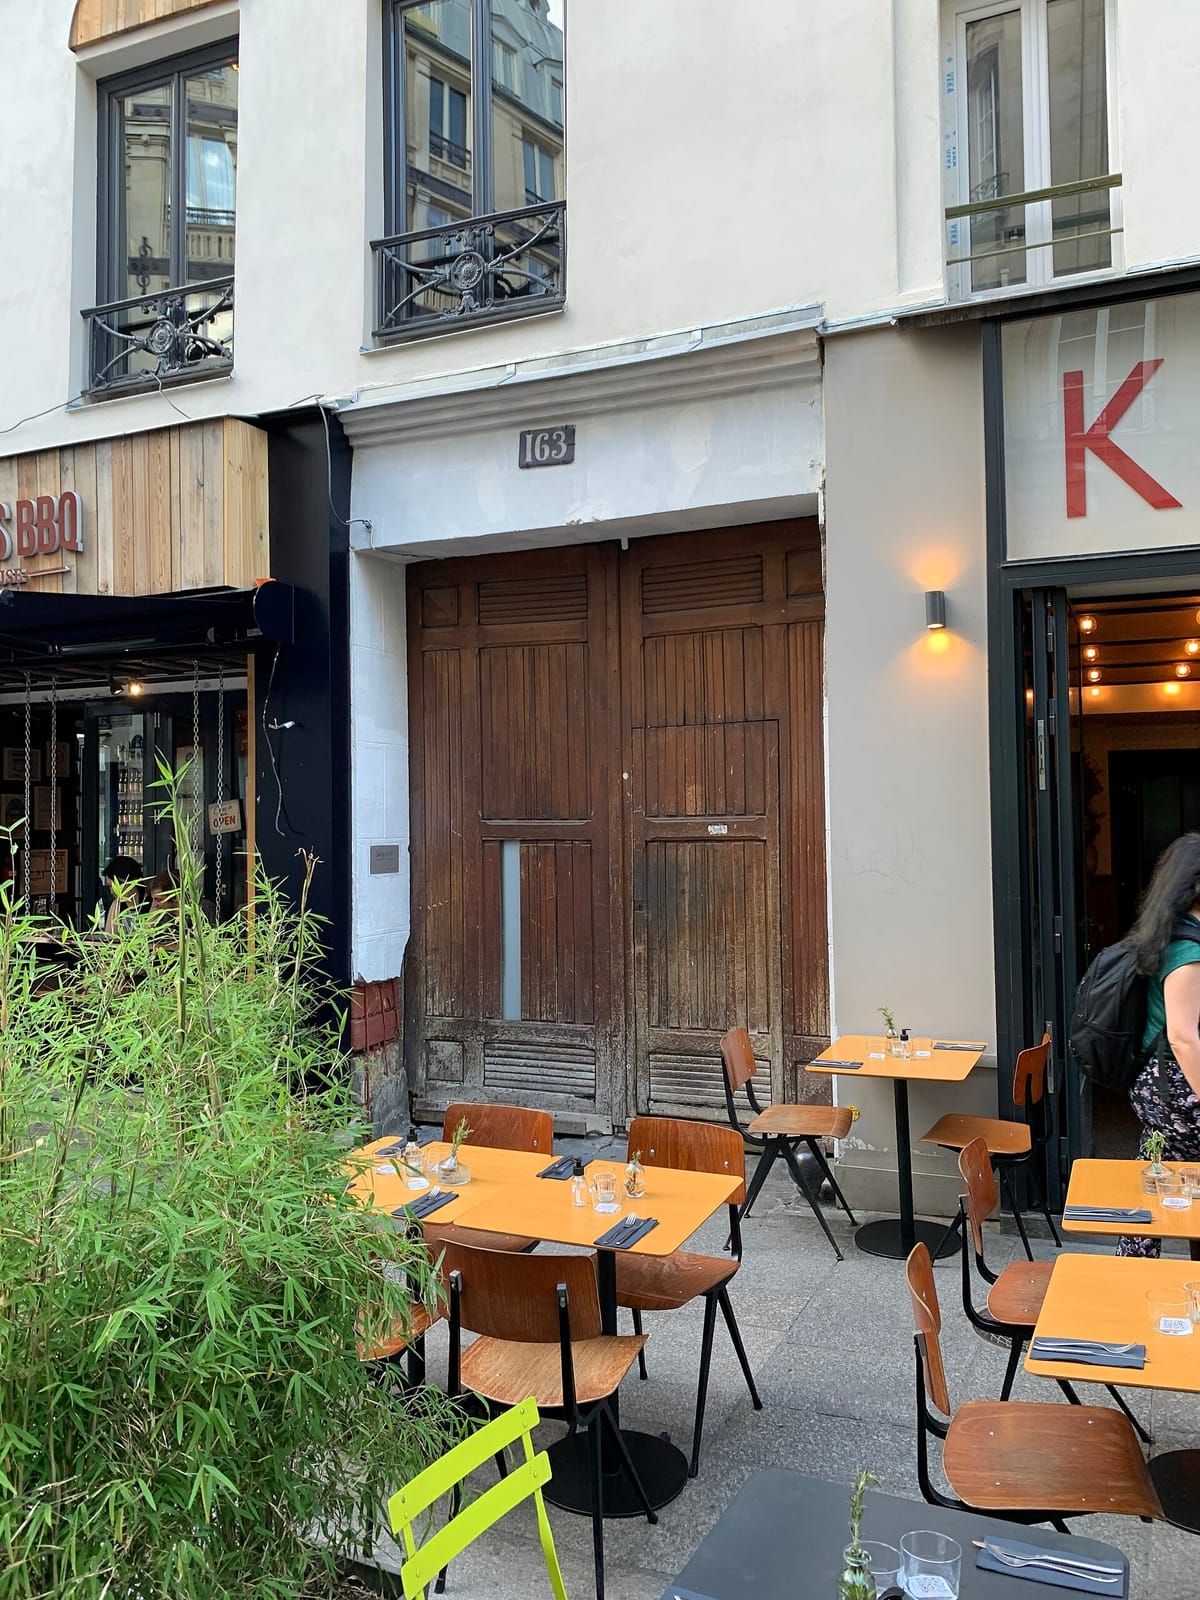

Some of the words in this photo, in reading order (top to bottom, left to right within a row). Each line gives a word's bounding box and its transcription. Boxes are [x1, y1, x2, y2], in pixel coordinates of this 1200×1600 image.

[525, 430, 567, 463] 163
[1063, 358, 1183, 518] K
[16, 490, 83, 557] BBQ
